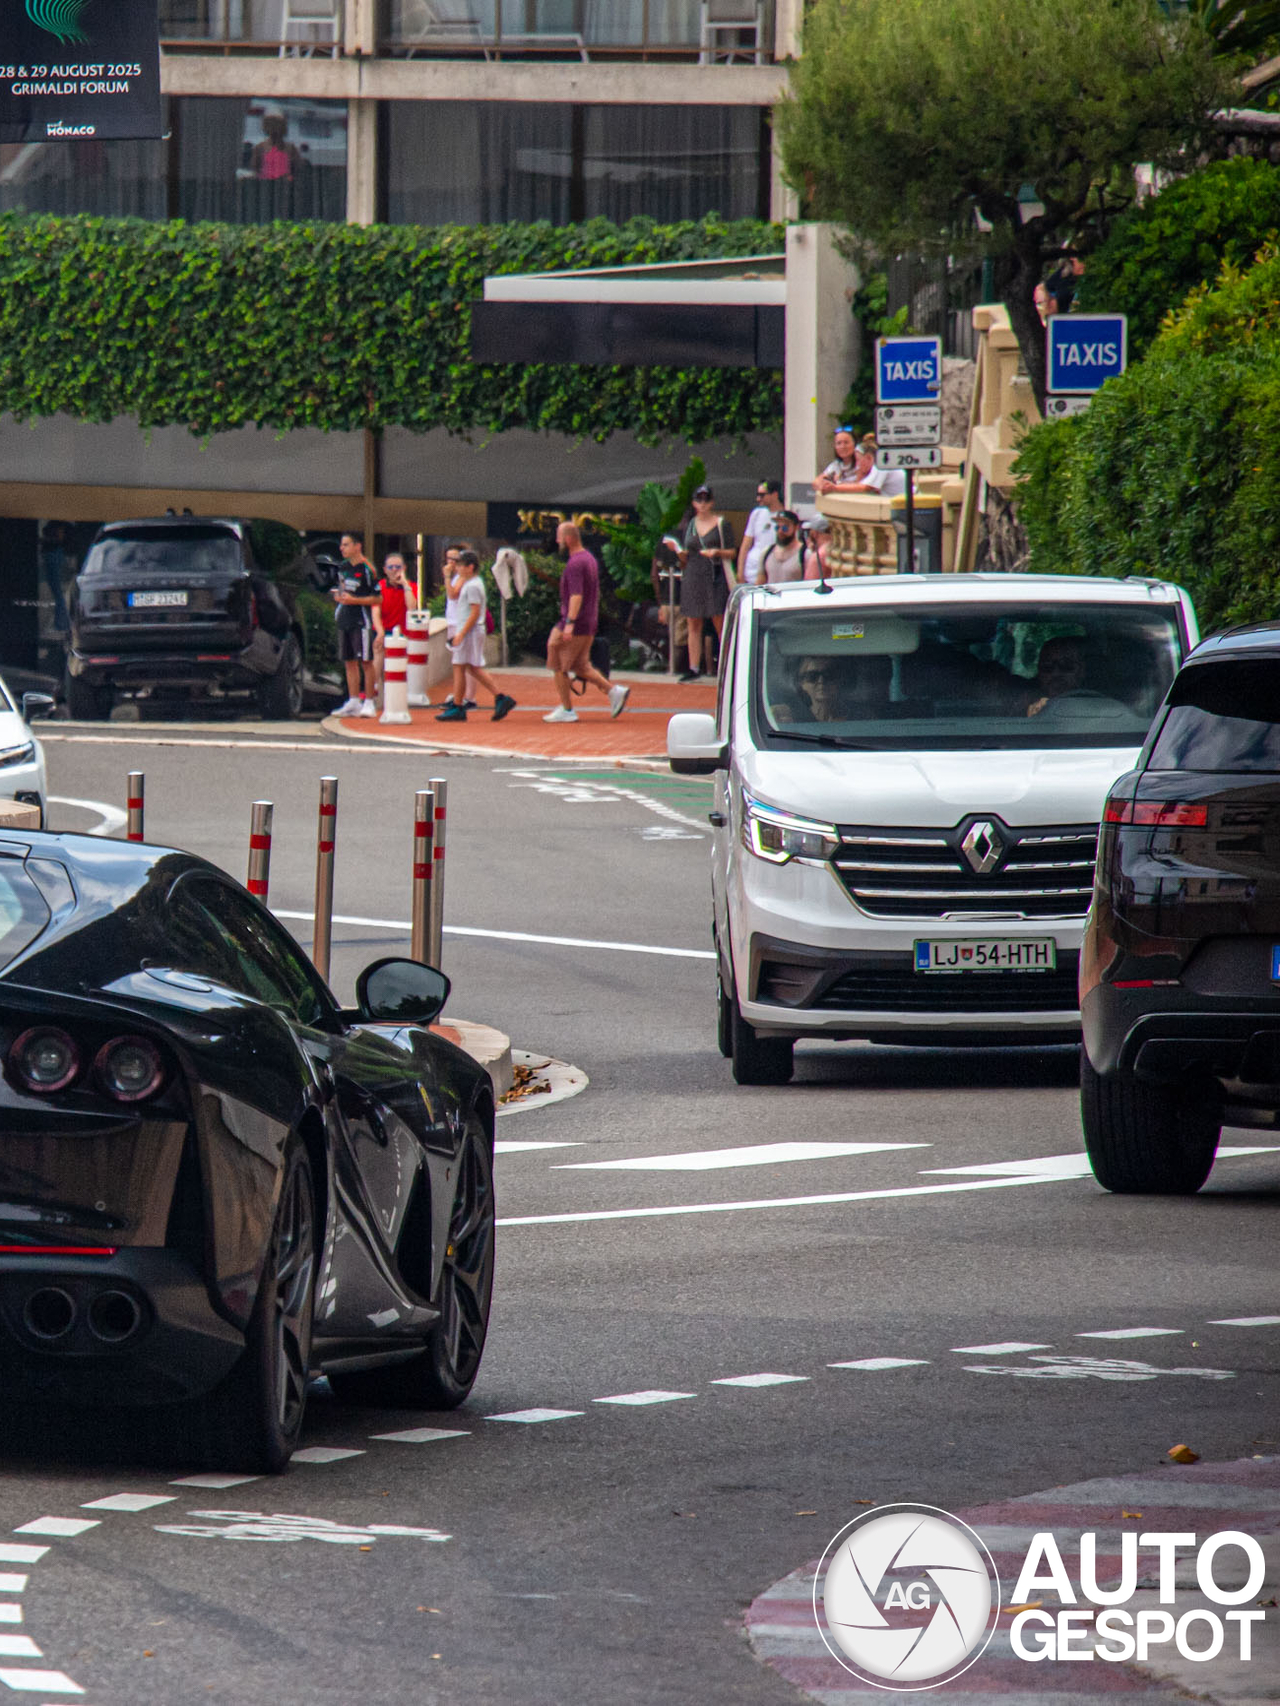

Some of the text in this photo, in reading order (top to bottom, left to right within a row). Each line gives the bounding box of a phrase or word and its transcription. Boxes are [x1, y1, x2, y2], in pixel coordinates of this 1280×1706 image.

[18, 66, 28, 78] &
[31, 65, 47, 78] 29
[50, 64, 104, 77] AUGUST
[107, 63, 141, 76] 2025
[11, 81, 129, 95] GRIMALDI FORUM
[47, 126, 95, 136] MONACO
[1056, 342, 1117, 367] TAXIS
[883, 361, 933, 381] TAXIS
[934, 943, 1048, 966] LJ 54-HTH
